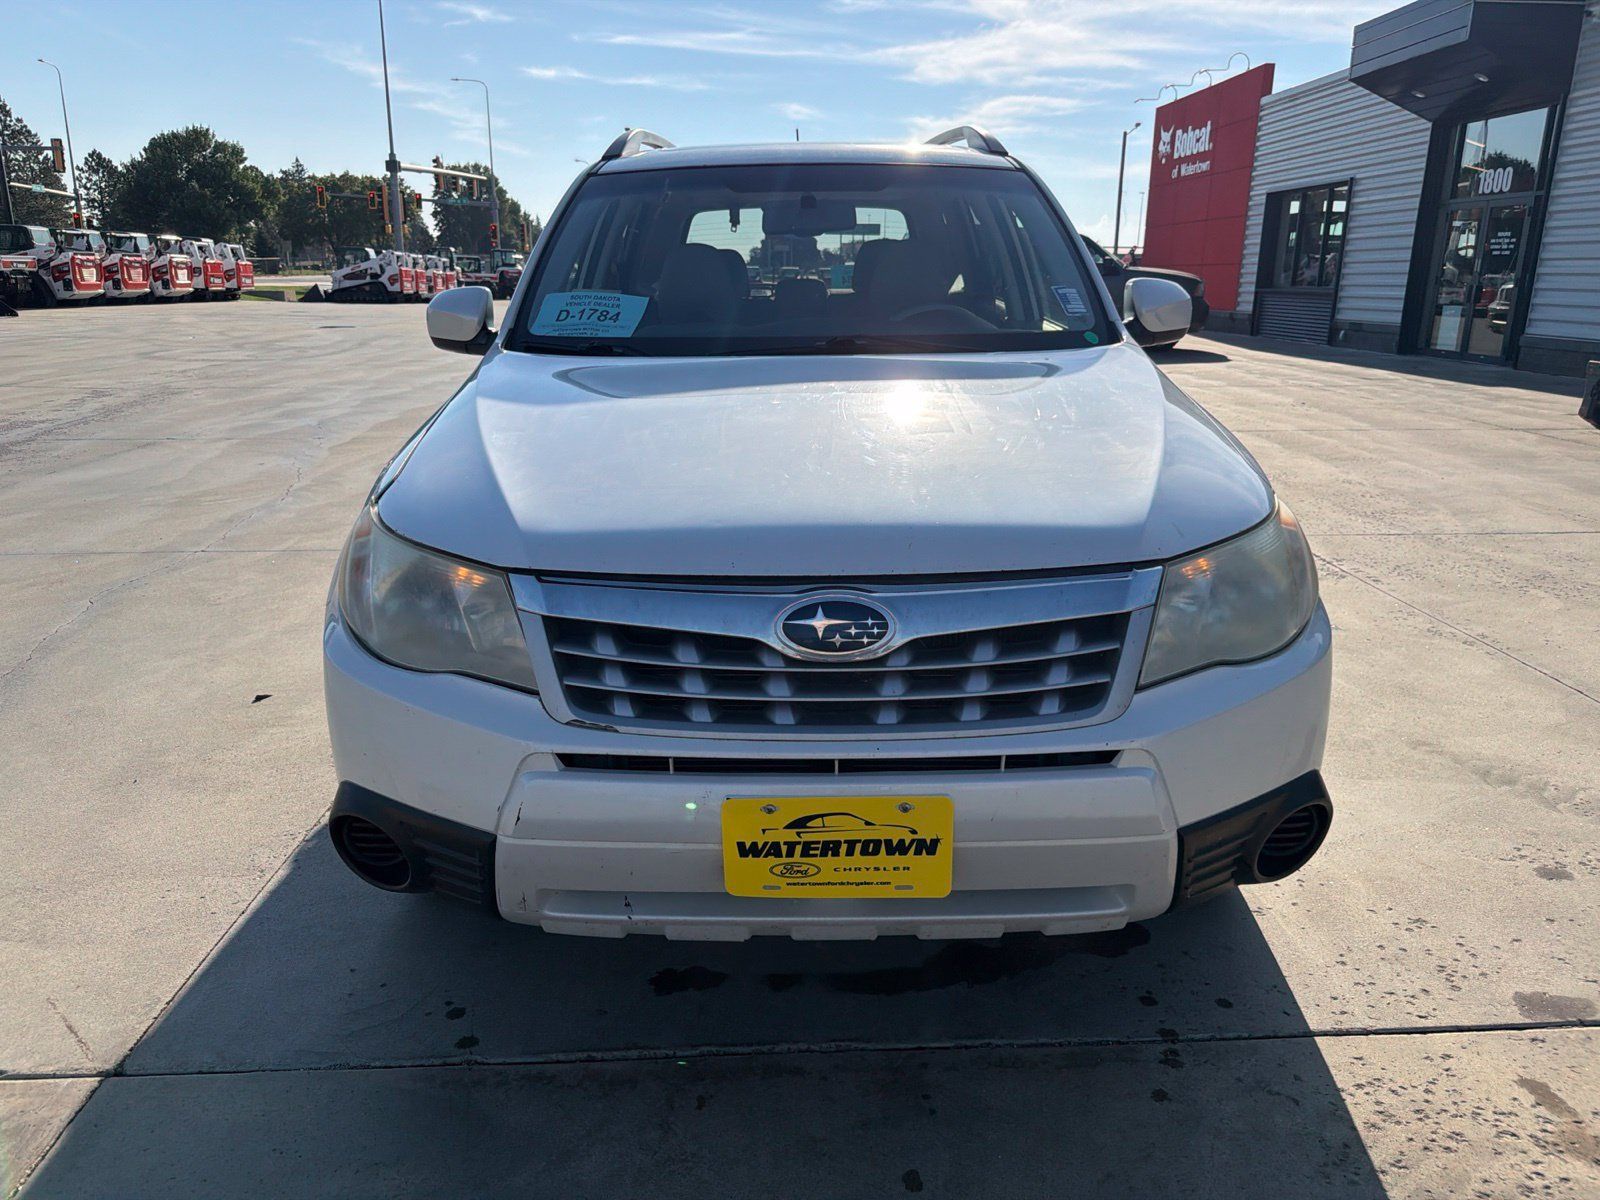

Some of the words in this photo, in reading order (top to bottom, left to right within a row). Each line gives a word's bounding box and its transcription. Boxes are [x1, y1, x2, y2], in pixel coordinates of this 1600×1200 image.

[1171, 165, 1179, 179] of
[1181, 160, 1210, 176] Watertown
[1479, 166, 1513, 194] 1800
[593, 294, 621, 302] DAKOTA
[593, 301, 621, 309] DEALER
[555, 308, 621, 323] D-1784
[736, 838, 939, 858] WATERTOWN
[779, 864, 810, 876] Ford
